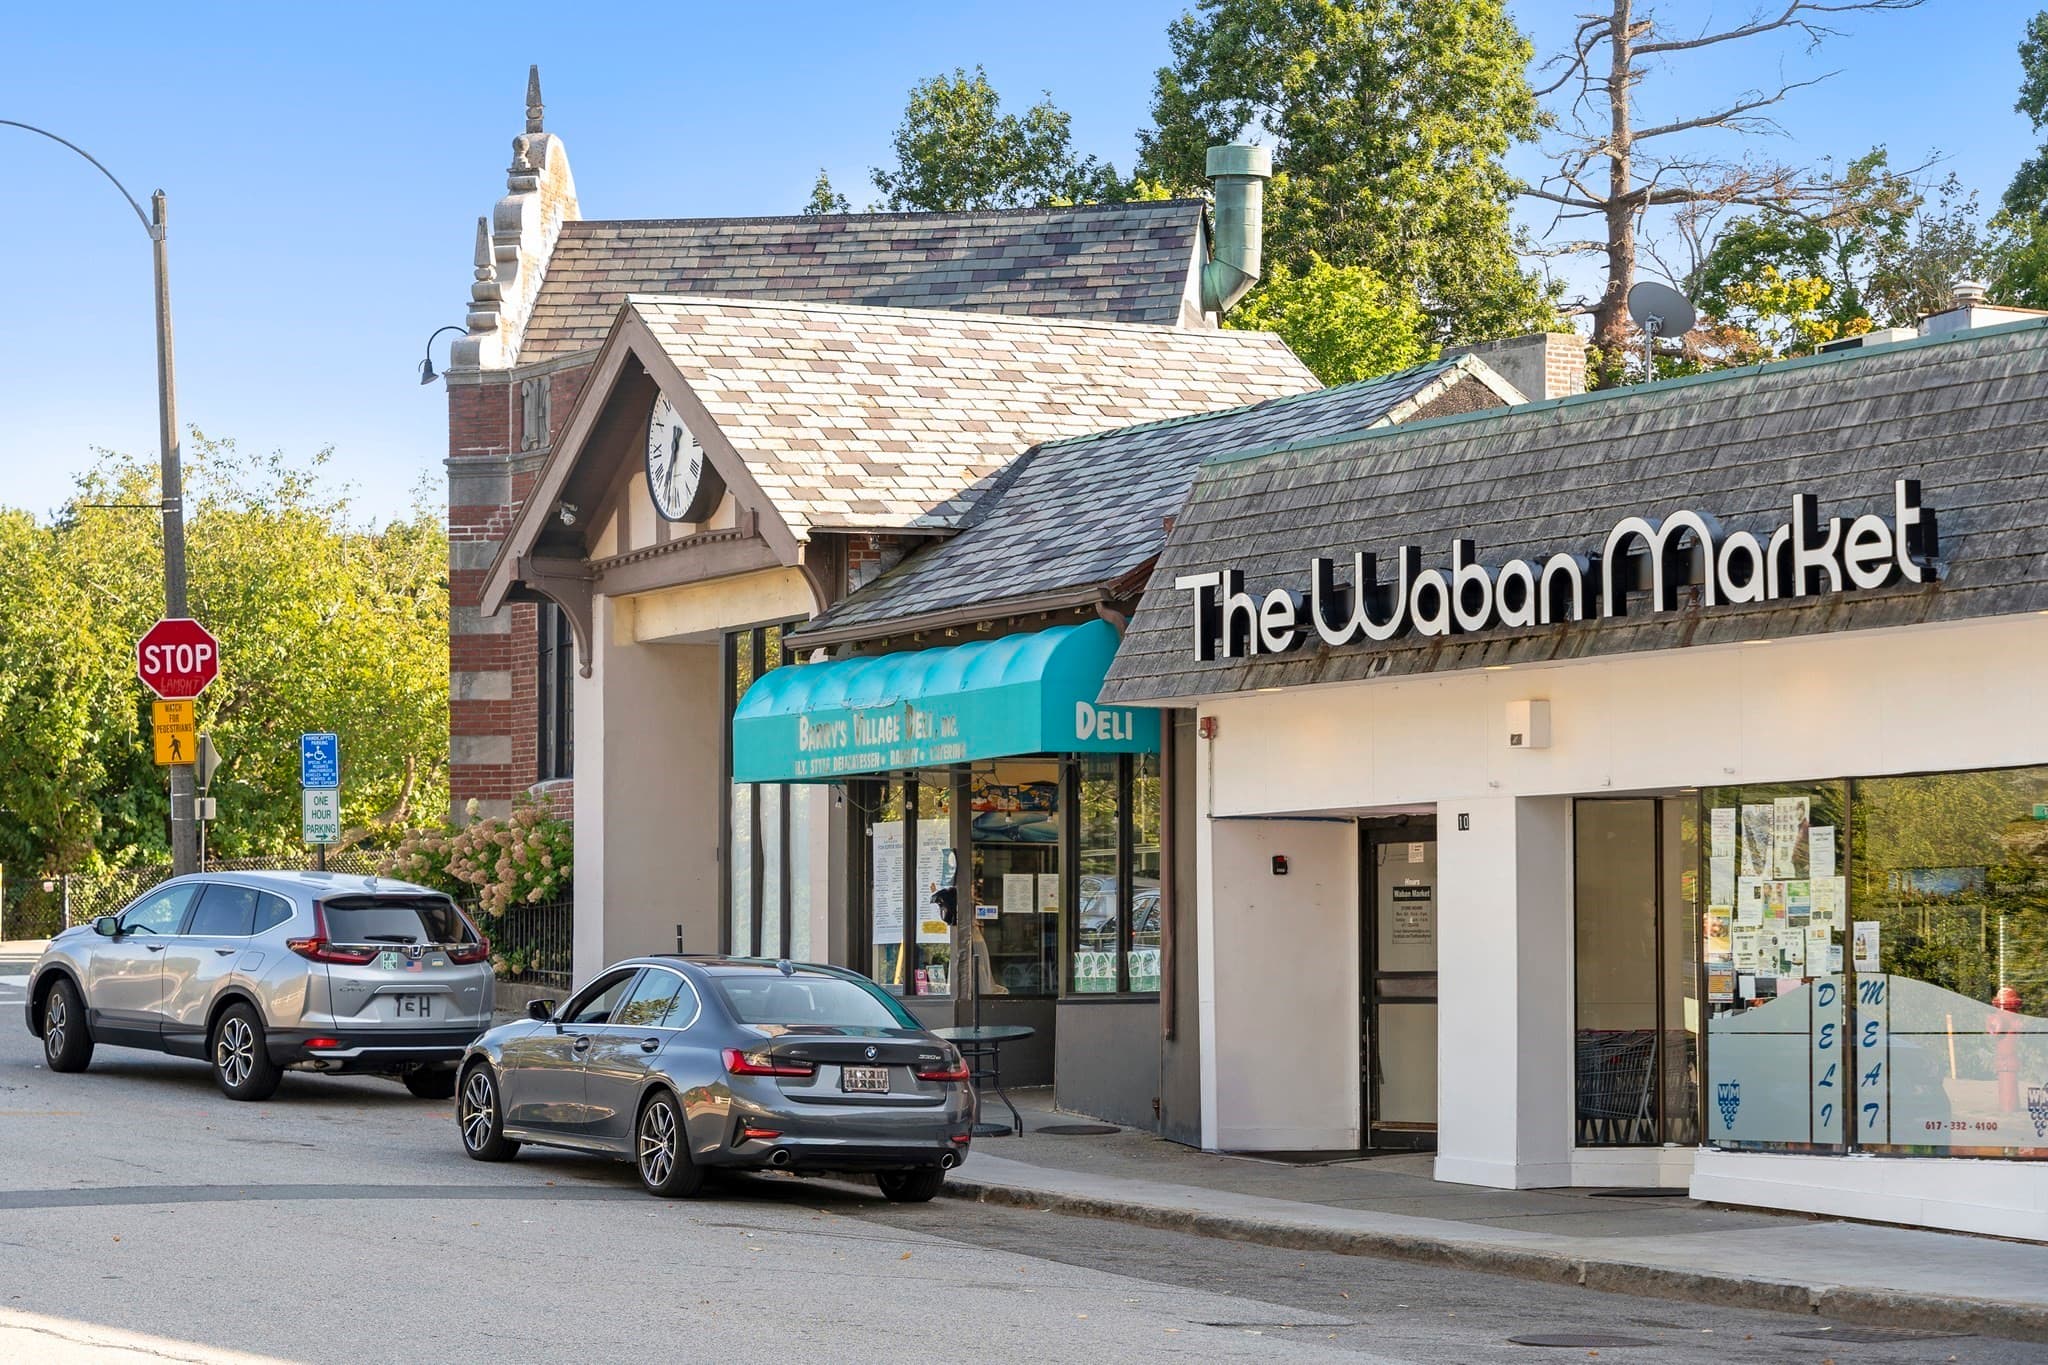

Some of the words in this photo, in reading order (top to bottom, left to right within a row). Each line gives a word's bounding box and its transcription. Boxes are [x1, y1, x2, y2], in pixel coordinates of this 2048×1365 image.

[1175, 570, 1296, 662] The
[1312, 539, 1583, 646] Waban
[1603, 479, 1922, 618] Market
[144, 644, 212, 675] STOP
[165, 703, 183, 712] WATCH
[169, 714, 180, 722] FOR
[1076, 701, 1132, 741] DELI
[157, 723, 193, 734] PEDESTRIANS
[853, 712, 900, 746] VILLAGE
[313, 796, 329, 806] ONE
[311, 810, 332, 819] HOUR
[1459, 815, 1469, 829] 10
[306, 824, 336, 834] PARKING
[1817, 982, 1836, 1128] DELI
[1859, 980, 1885, 1129] MEAT
[1925, 1121, 1942, 1130] 617
[1950, 1121, 1967, 1130] 332
[1975, 1122, 1998, 1131] 4100
